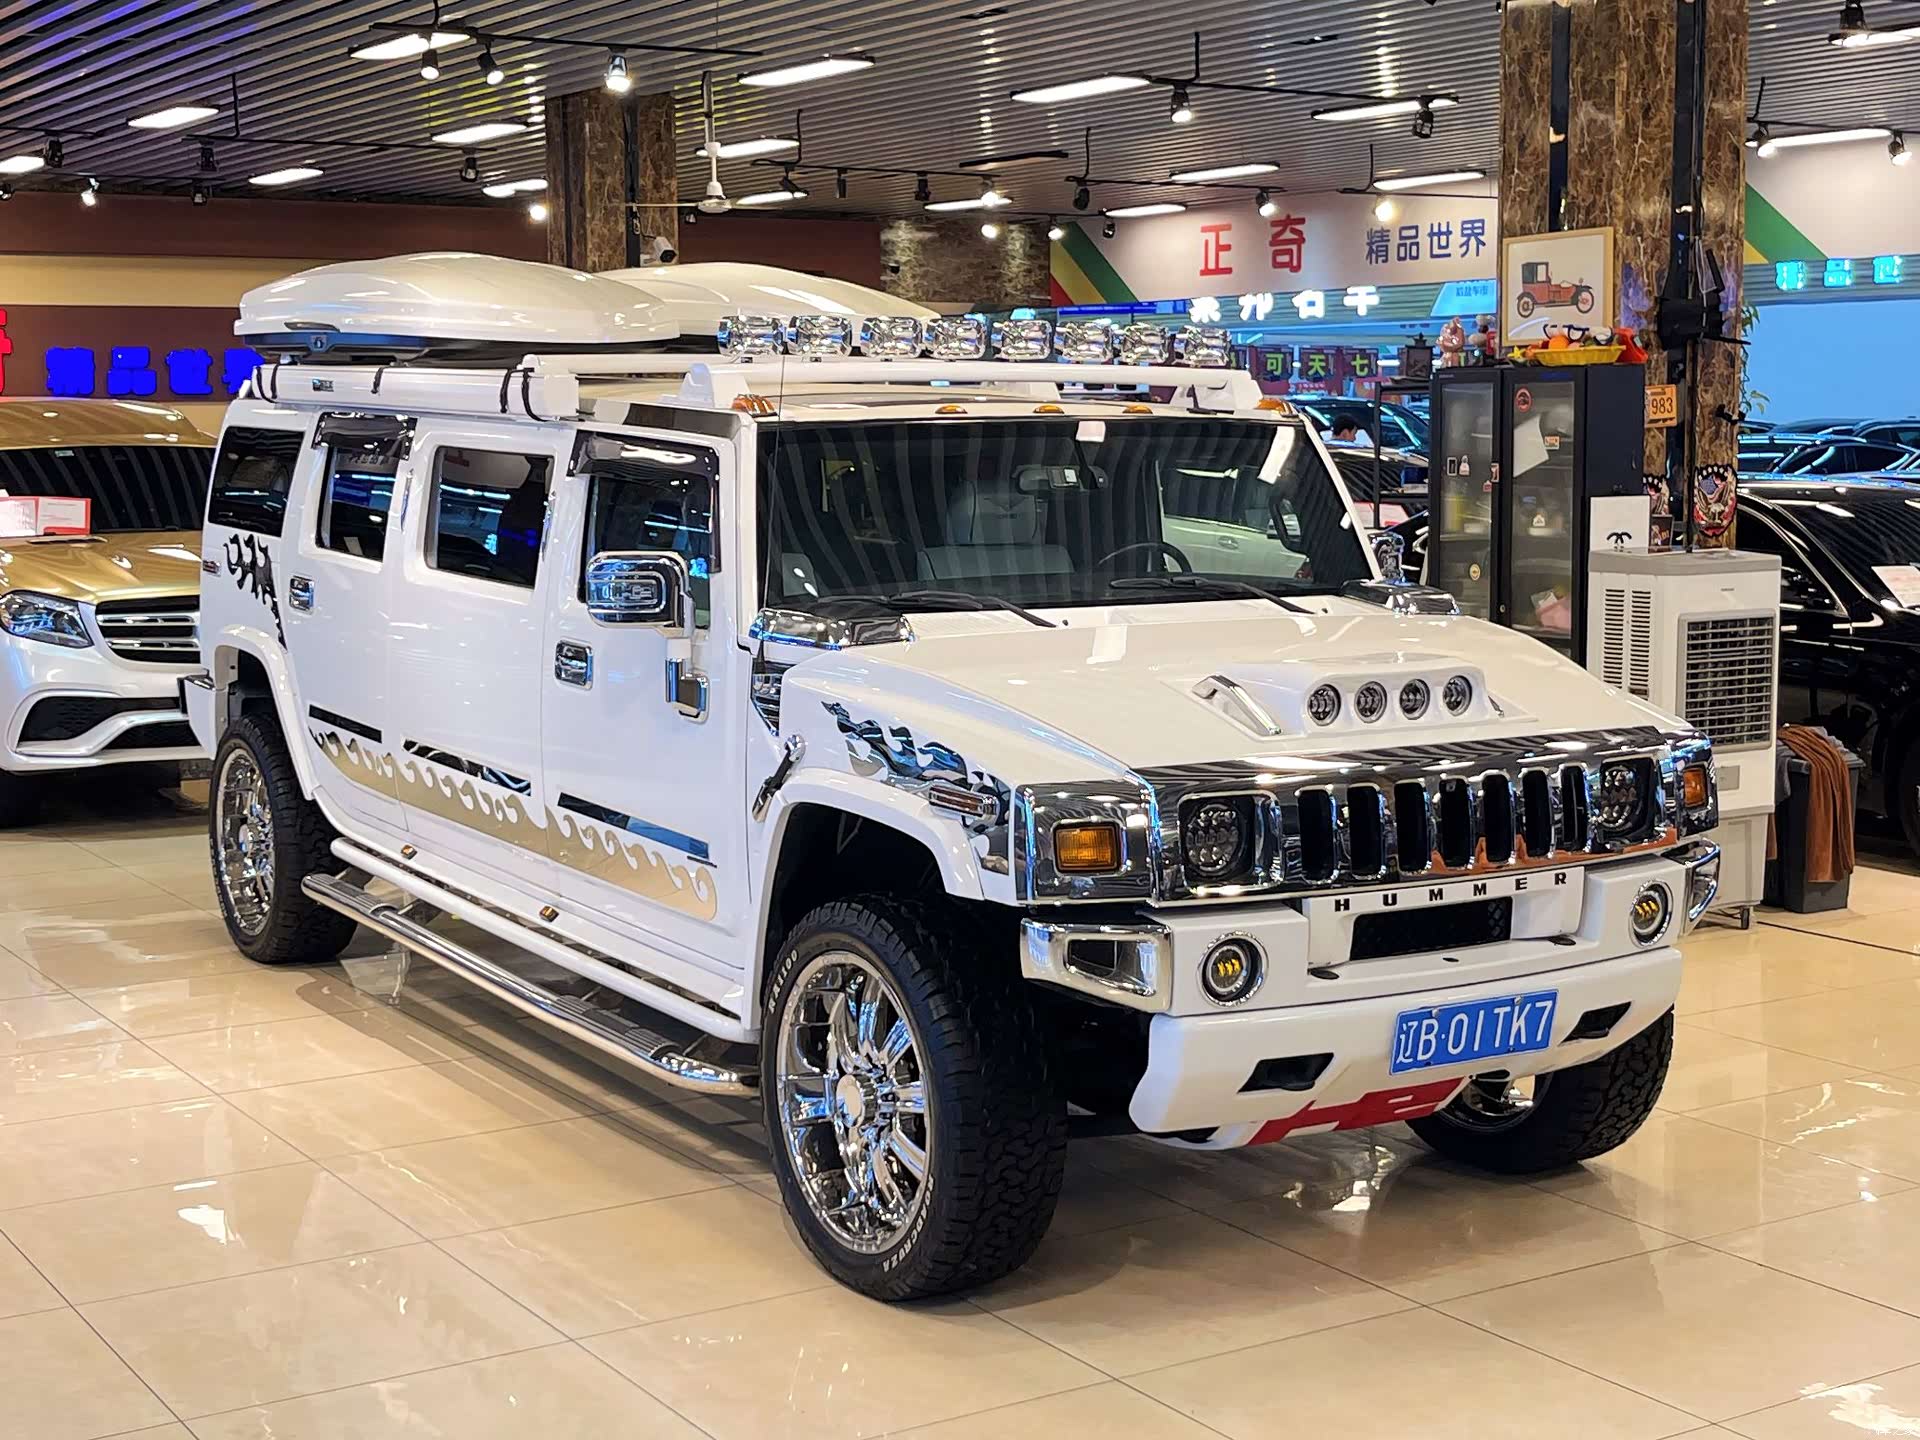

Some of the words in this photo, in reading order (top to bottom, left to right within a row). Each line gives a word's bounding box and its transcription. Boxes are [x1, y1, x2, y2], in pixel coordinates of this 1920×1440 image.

[1199, 213, 1307, 277] 正奇
[1365, 217, 1487, 266] 精品世界
[1651, 397, 1673, 415] 983
[1334, 871, 1567, 912] HUMMER
